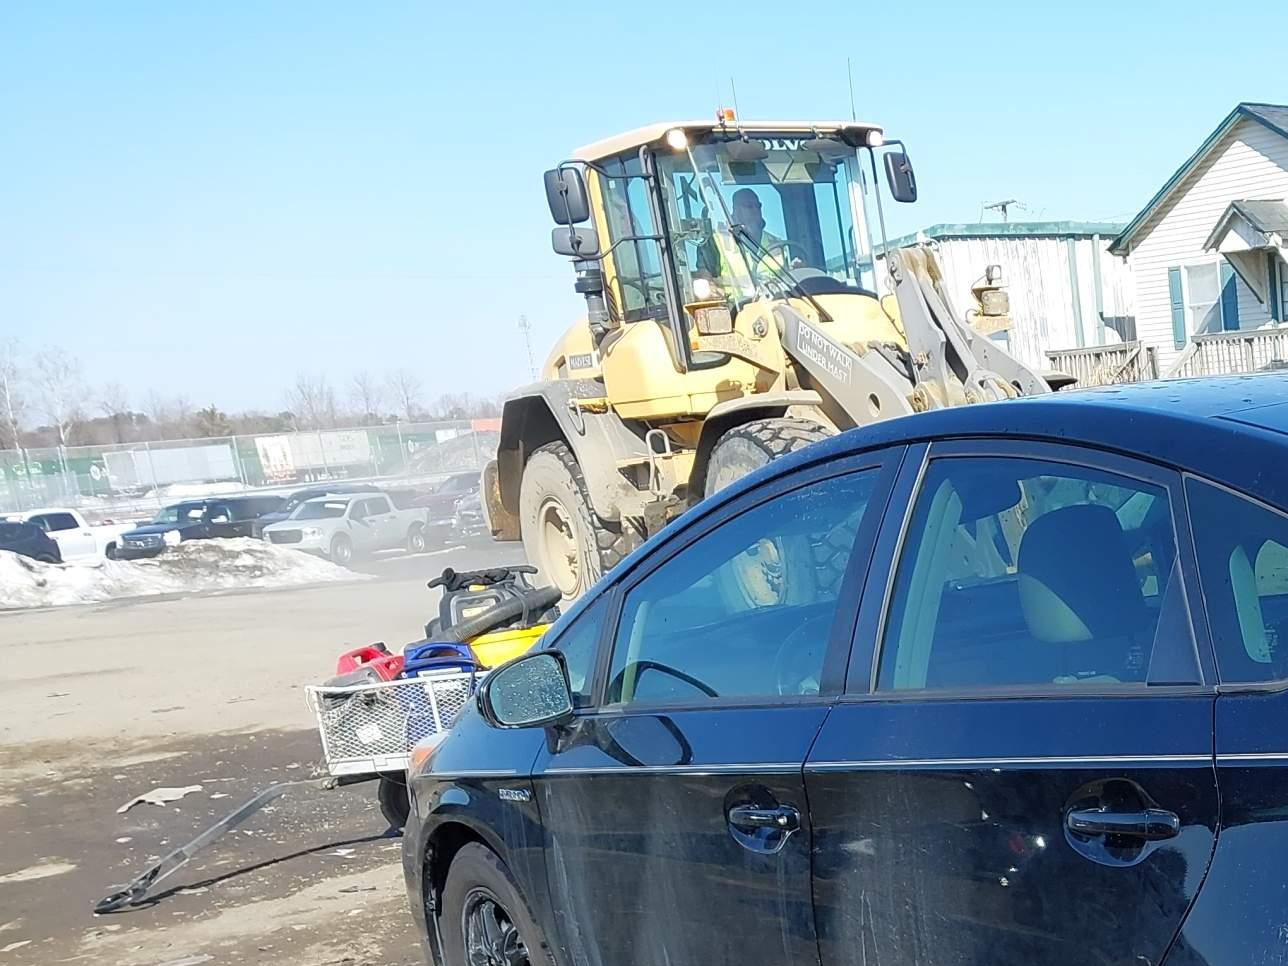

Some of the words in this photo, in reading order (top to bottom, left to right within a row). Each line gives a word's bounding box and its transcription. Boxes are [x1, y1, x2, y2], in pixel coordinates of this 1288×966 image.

[802, 341, 827, 369] UNDER
[827, 361, 848, 383] MAST
[811, 331, 828, 352] NOT
[829, 343, 852, 369] WALK
